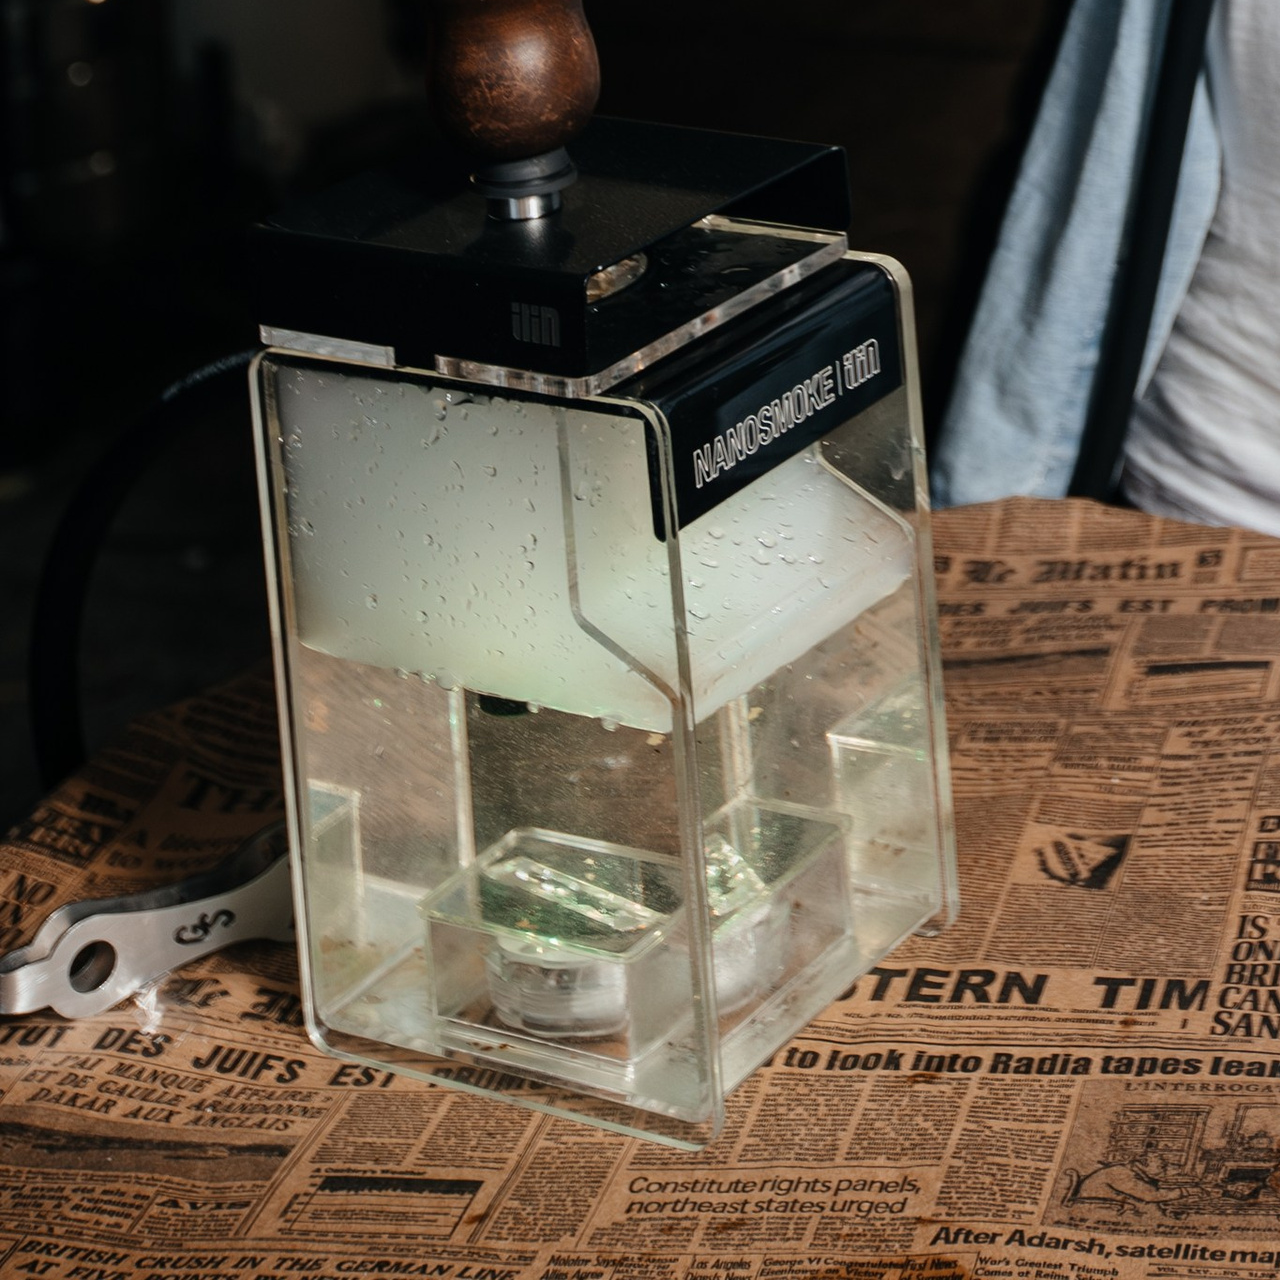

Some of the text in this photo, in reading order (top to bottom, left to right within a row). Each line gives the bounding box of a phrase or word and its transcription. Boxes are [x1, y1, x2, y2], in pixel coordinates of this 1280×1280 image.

[692, 365, 836, 489] NANOSMOKE
[1236, 915, 1270, 940] IS
[93, 1027, 173, 1059] DES
[191, 1044, 307, 1084] JUIFS
[784, 1047, 820, 1069] to
[826, 1049, 904, 1072] look
[910, 1049, 984, 1075] into
[988, 1052, 1092, 1076] Radia
[1100, 1053, 1203, 1077] tapes
[26, 1087, 118, 1116] DAKAR
[628, 1174, 921, 1197] Constitute rights panels,
[624, 1197, 908, 1218] northeast states urged
[929, 1226, 1003, 1246] After
[1003, 1228, 1112, 1260] Adarsh,
[1115, 1242, 1227, 1263] satellite
[16, 1258, 60, 1276] AT
[18, 1239, 131, 1267] BRITISH
[134, 1255, 229, 1270] CRUSH
[231, 1255, 266, 1271] IN
[271, 1255, 329, 1273] THE
[335, 1259, 454, 1279] GERMAN
[712, 1257, 752, 1271] Angeles
[763, 1257, 804, 1267] George
[930, 1258, 959, 1270] News
[978, 1256, 1120, 1278] War's Greatest Triumph
[759, 1267, 820, 1277] Eisenhower
[847, 1268, 887, 1279] Victory
[975, 1267, 1013, 1278] Comes
